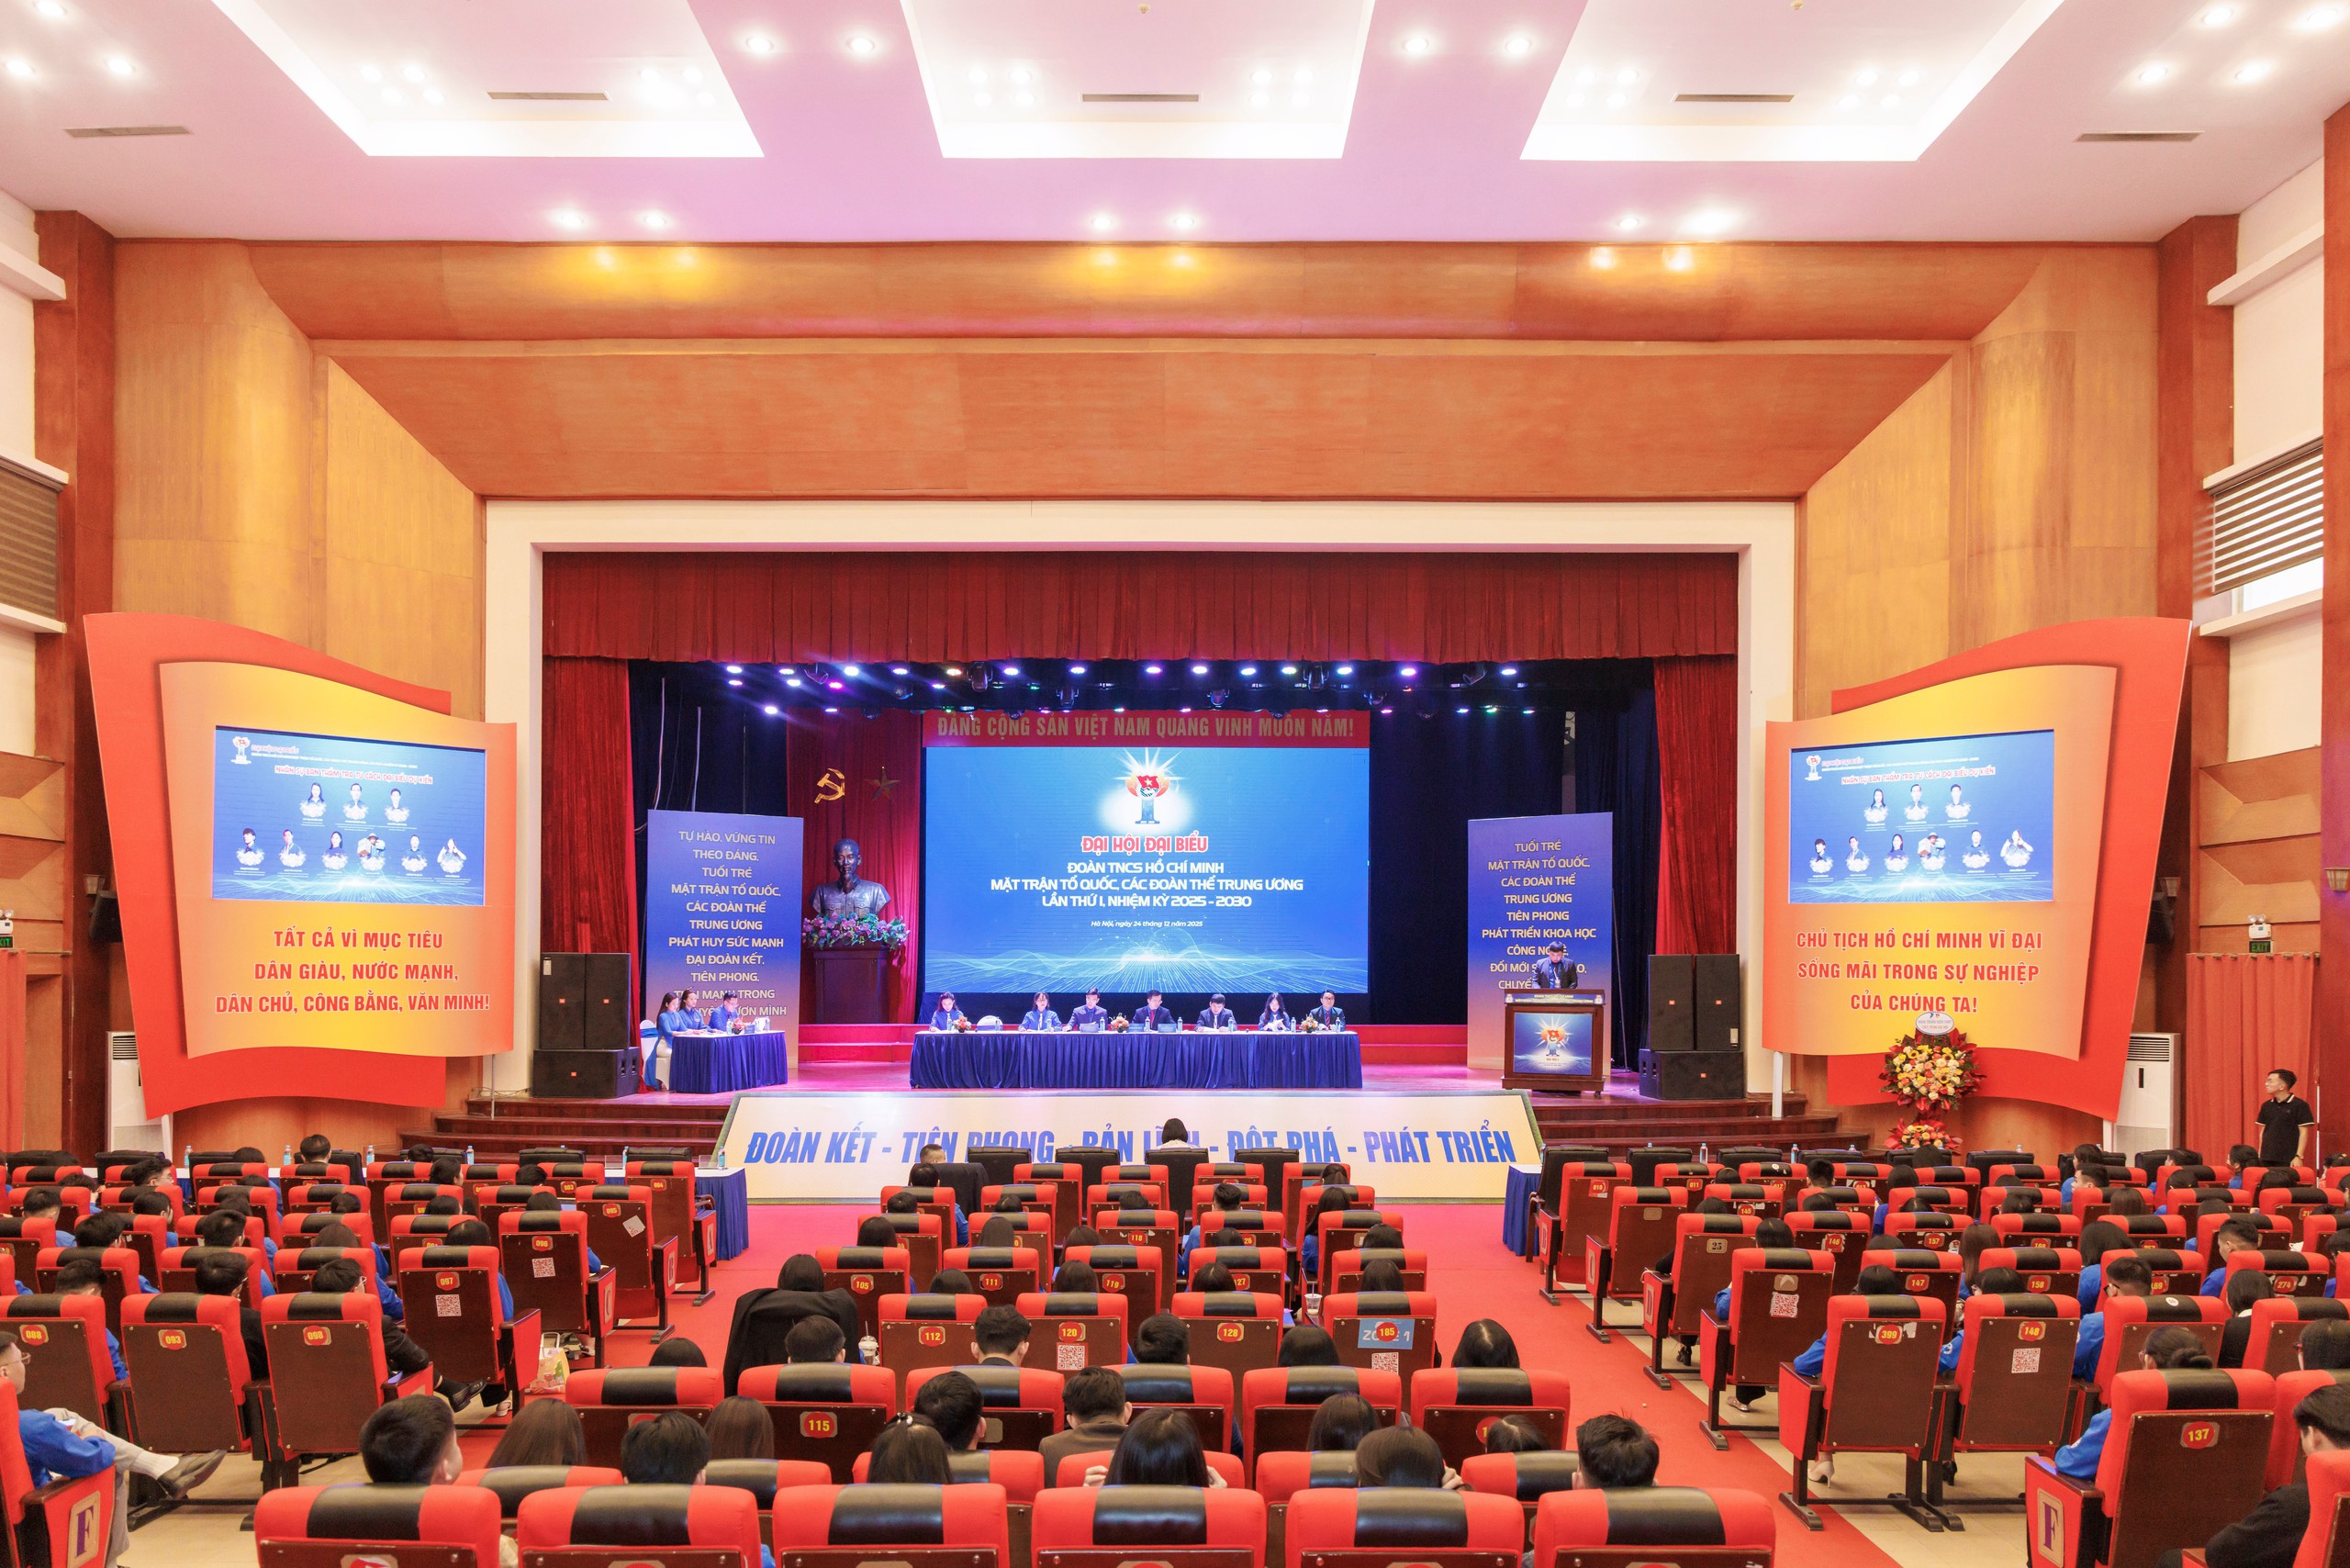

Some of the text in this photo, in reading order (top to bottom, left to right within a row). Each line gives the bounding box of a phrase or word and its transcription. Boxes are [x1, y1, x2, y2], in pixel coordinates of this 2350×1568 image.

[987, 713, 1029, 740] CỘNG
[1074, 713, 1108, 740] VIỆT
[1113, 716, 1149, 736] NAM
[1157, 717, 1209, 738] QUANG
[1215, 717, 1252, 736] VINH
[1259, 714, 1304, 736] MUÔN
[1311, 714, 1353, 736] NĂM!
[678, 830, 695, 844] TỰ
[724, 831, 756, 844] VỮNG
[758, 834, 776, 846] TIN
[1080, 830, 1209, 856] ĐẠI HỘI ĐẠI BIỂU
[692, 849, 723, 860] THEO
[1067, 858, 1224, 874] ĐOÀN TNCS HỒ CHÍ MINH
[1488, 859, 1510, 872] MẶT
[1511, 858, 1539, 872] TRẬN
[990, 875, 1304, 893] MẶT TRẬN TỔ QUỐC, CÁC ĐOÀN THỂ TRUNG ƯƠNG
[1501, 875, 1521, 888] CÁC
[1523, 875, 1553, 888] ĐOÀN
[671, 882, 697, 896] MẶT
[699, 882, 730, 897] TRẬN
[1042, 891, 1252, 909] LẦN THỨ I, NHIỆM KỲ 2025 2030
[1503, 892, 1572, 904] TRUNG ƯƠNG
[686, 900, 709, 913] CÁC
[711, 900, 743, 913] ĐOÀN
[1506, 910, 1570, 922] TIÊN PHONG
[689, 919, 763, 931] TRUNG ƯƠNG
[274, 925, 442, 952] TẤT CẢ VÌ MỤC TIÊU
[1482, 925, 1597, 941] PHÁT TRIỂN KHOA HỌC
[668, 935, 784, 950] PHÁT HUY SỨC MẠNH
[1796, 927, 2042, 953] CHỦ TỊCH HỒ CHÍ MINH VĨ ĐẠI
[1506, 944, 1536, 956] CÔNG
[2251, 942, 2268, 952] EXIT
[686, 955, 706, 967] ĐẠI
[708, 953, 740, 965] ĐOÀN
[254, 960, 459, 983] DÂN GIÀU, NƯỚC MẠNH,
[1509, 961, 1530, 973] MỚI
[1797, 958, 2041, 985] SỐNG MÃI TRONG SỰ NGHIỆP
[690, 970, 717, 982] TIÊN
[737, 990, 776, 1000] TRONG
[216, 990, 490, 1014] DÂN CHỦ, CÔNG BẰNG, VĂN MINH!
[1851, 989, 1978, 1014] CỦA CHÚNG TA!
[759, 1004, 788, 1016] MÌNH
[744, 1126, 822, 1164] ĐOÀN
[824, 1121, 878, 1164] KẾT
[1286, 1126, 1342, 1163] PHÁ
[1363, 1126, 1431, 1163] PHÁT
[1436, 1119, 1517, 1163] TRIỂN
[535, 1239, 549, 1249] 096
[1712, 1241, 1722, 1251] 25
[440, 1277, 453, 1286] 097
[856, 1281, 869, 1290] 105
[985, 1278, 998, 1286] 111
[1106, 1279, 1119, 1288] 119
[1912, 1279, 1925, 1287] 147
[2031, 1281, 2044, 1289] 158
[26, 1330, 42, 1339] 088
[307, 1330, 324, 1340] 098
[924, 1332, 940, 1341] 112
[1062, 1327, 1078, 1338] 120
[1223, 1327, 1238, 1337] 128
[1380, 1327, 1395, 1337] 185
[1882, 1330, 1897, 1339] 399
[2024, 1327, 2040, 1337] 148
[165, 1335, 182, 1345] 093
[809, 1420, 830, 1431] 115
[2188, 1428, 2210, 1442] 137
[76, 1505, 95, 1558] F
[2042, 1501, 2059, 1551] F
